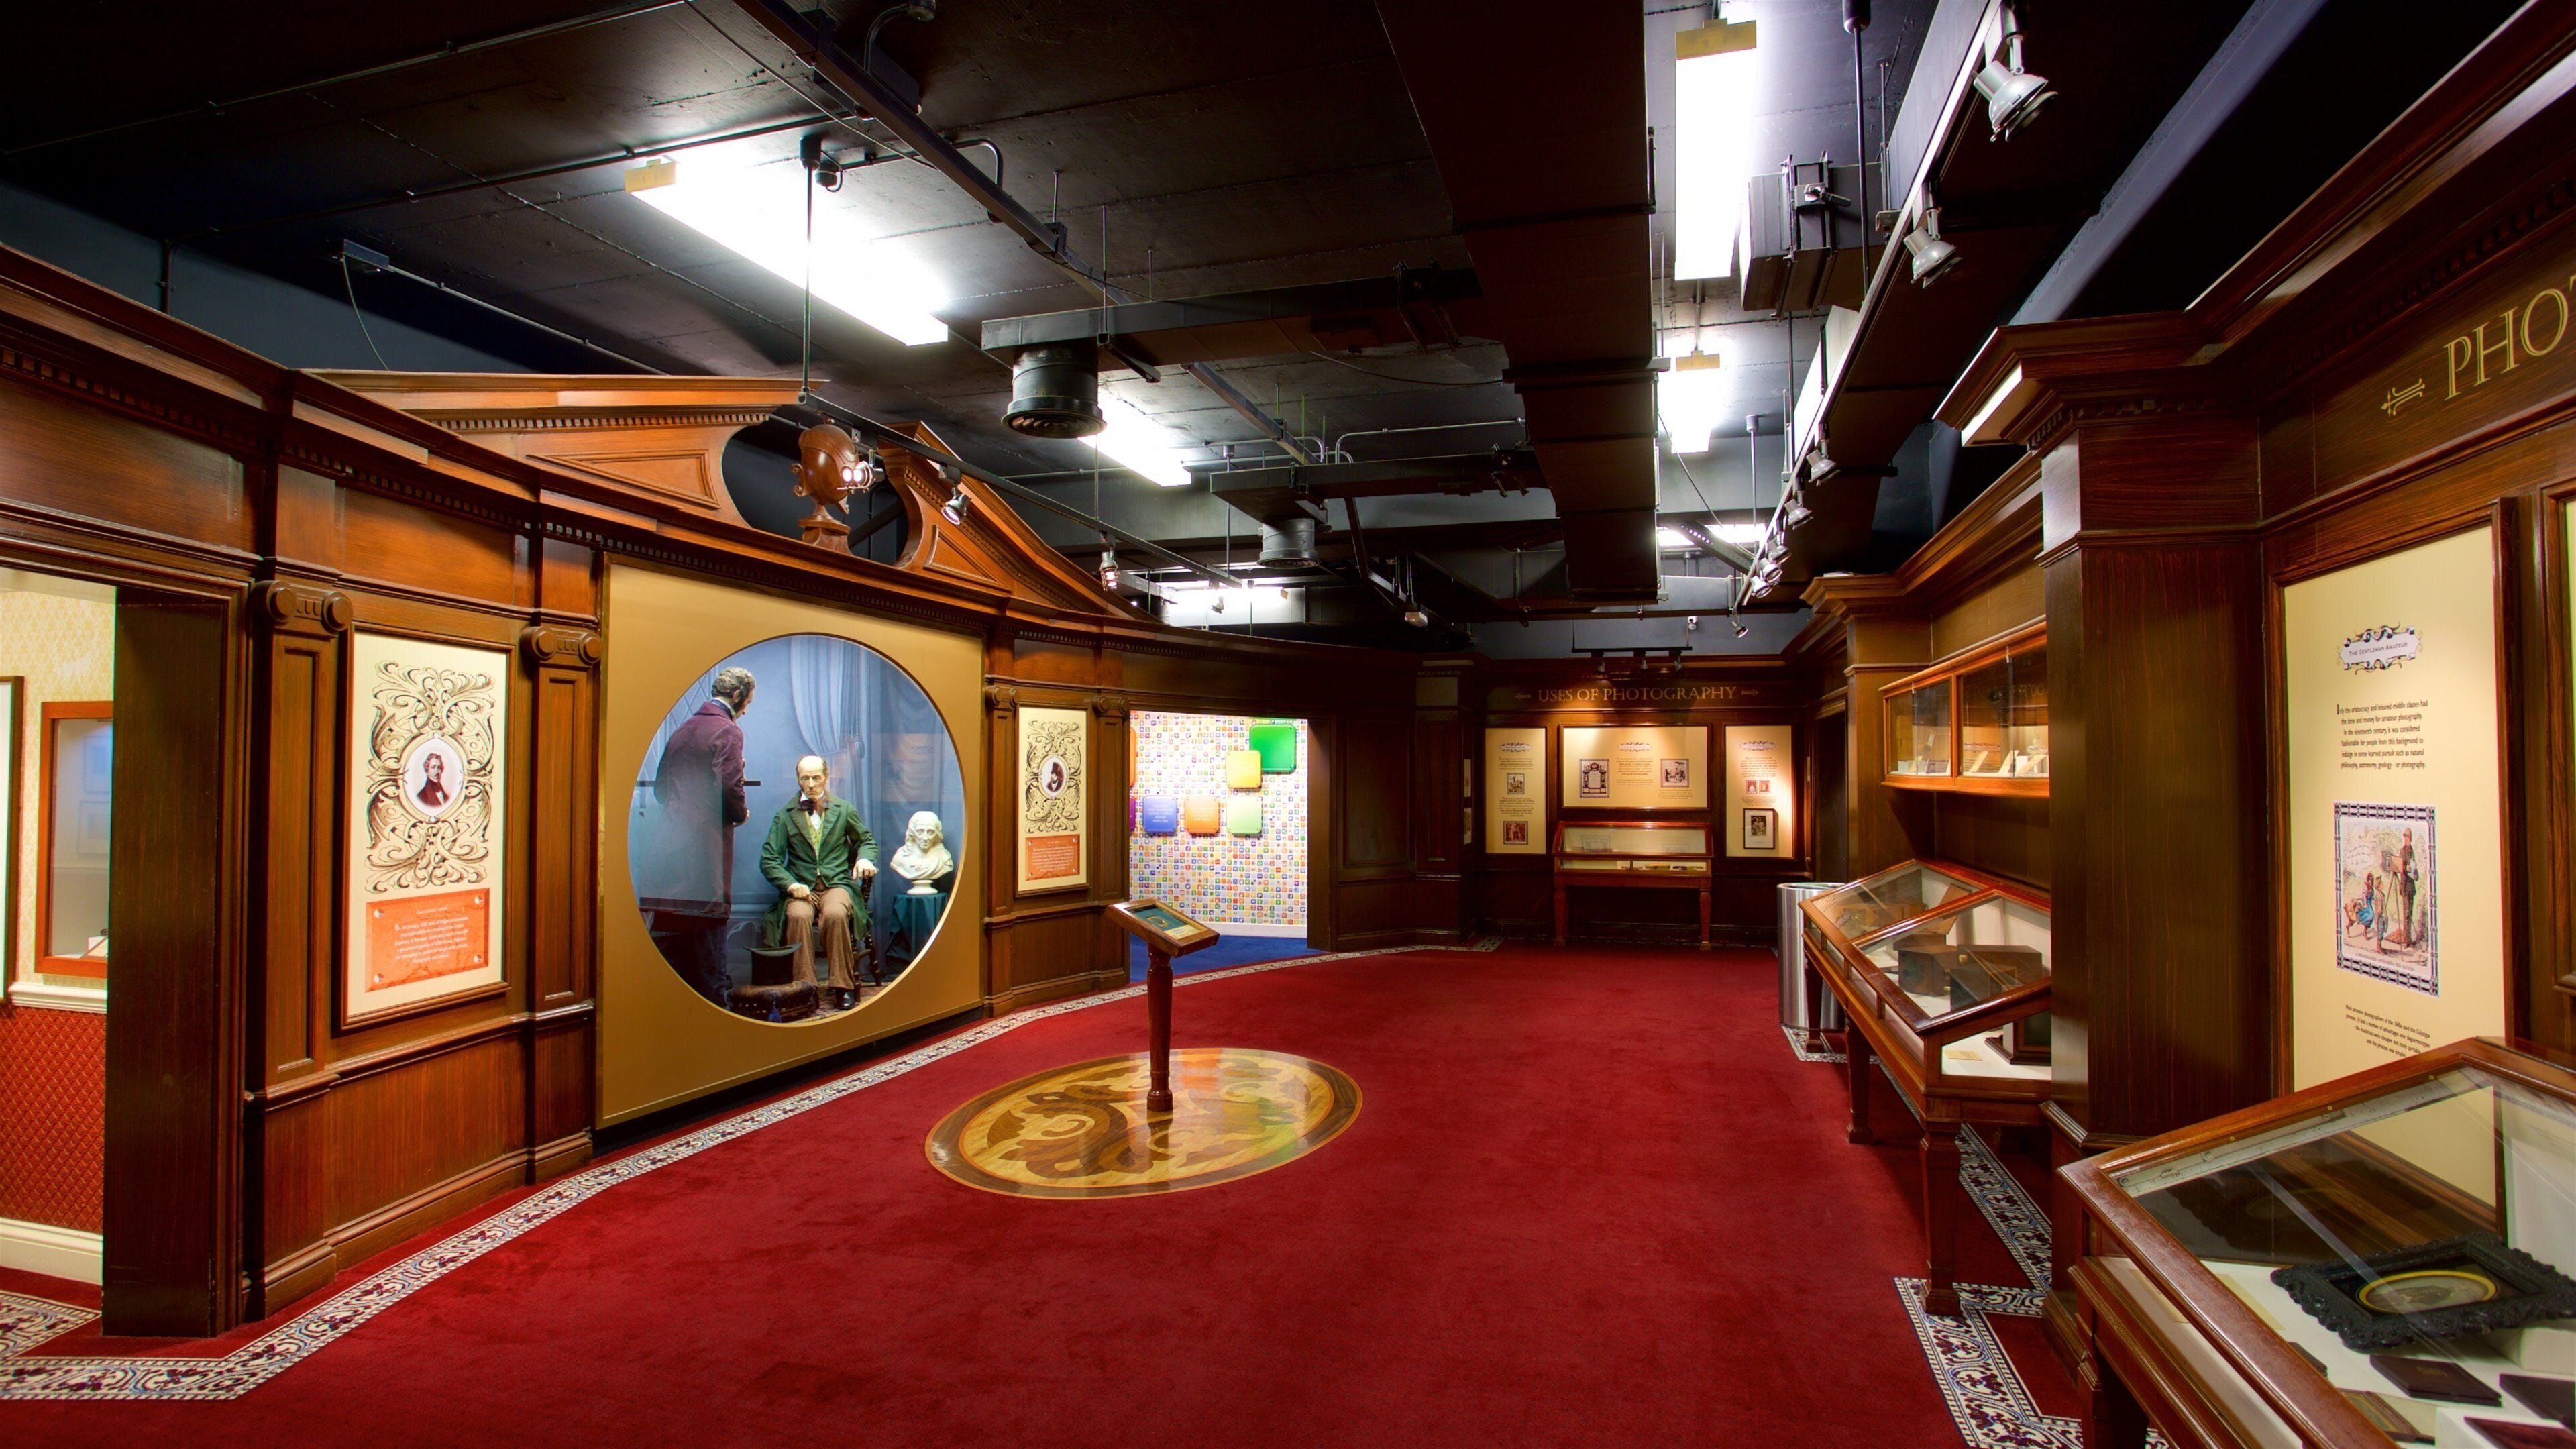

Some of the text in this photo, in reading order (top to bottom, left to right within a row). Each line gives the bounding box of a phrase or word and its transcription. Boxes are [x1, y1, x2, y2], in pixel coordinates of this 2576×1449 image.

[2443, 274, 2576, 401] PHO
[2358, 647, 2384, 655] GENTLEMAN
[1538, 686, 1736, 702] USES OF PHOTOGRAPHY
